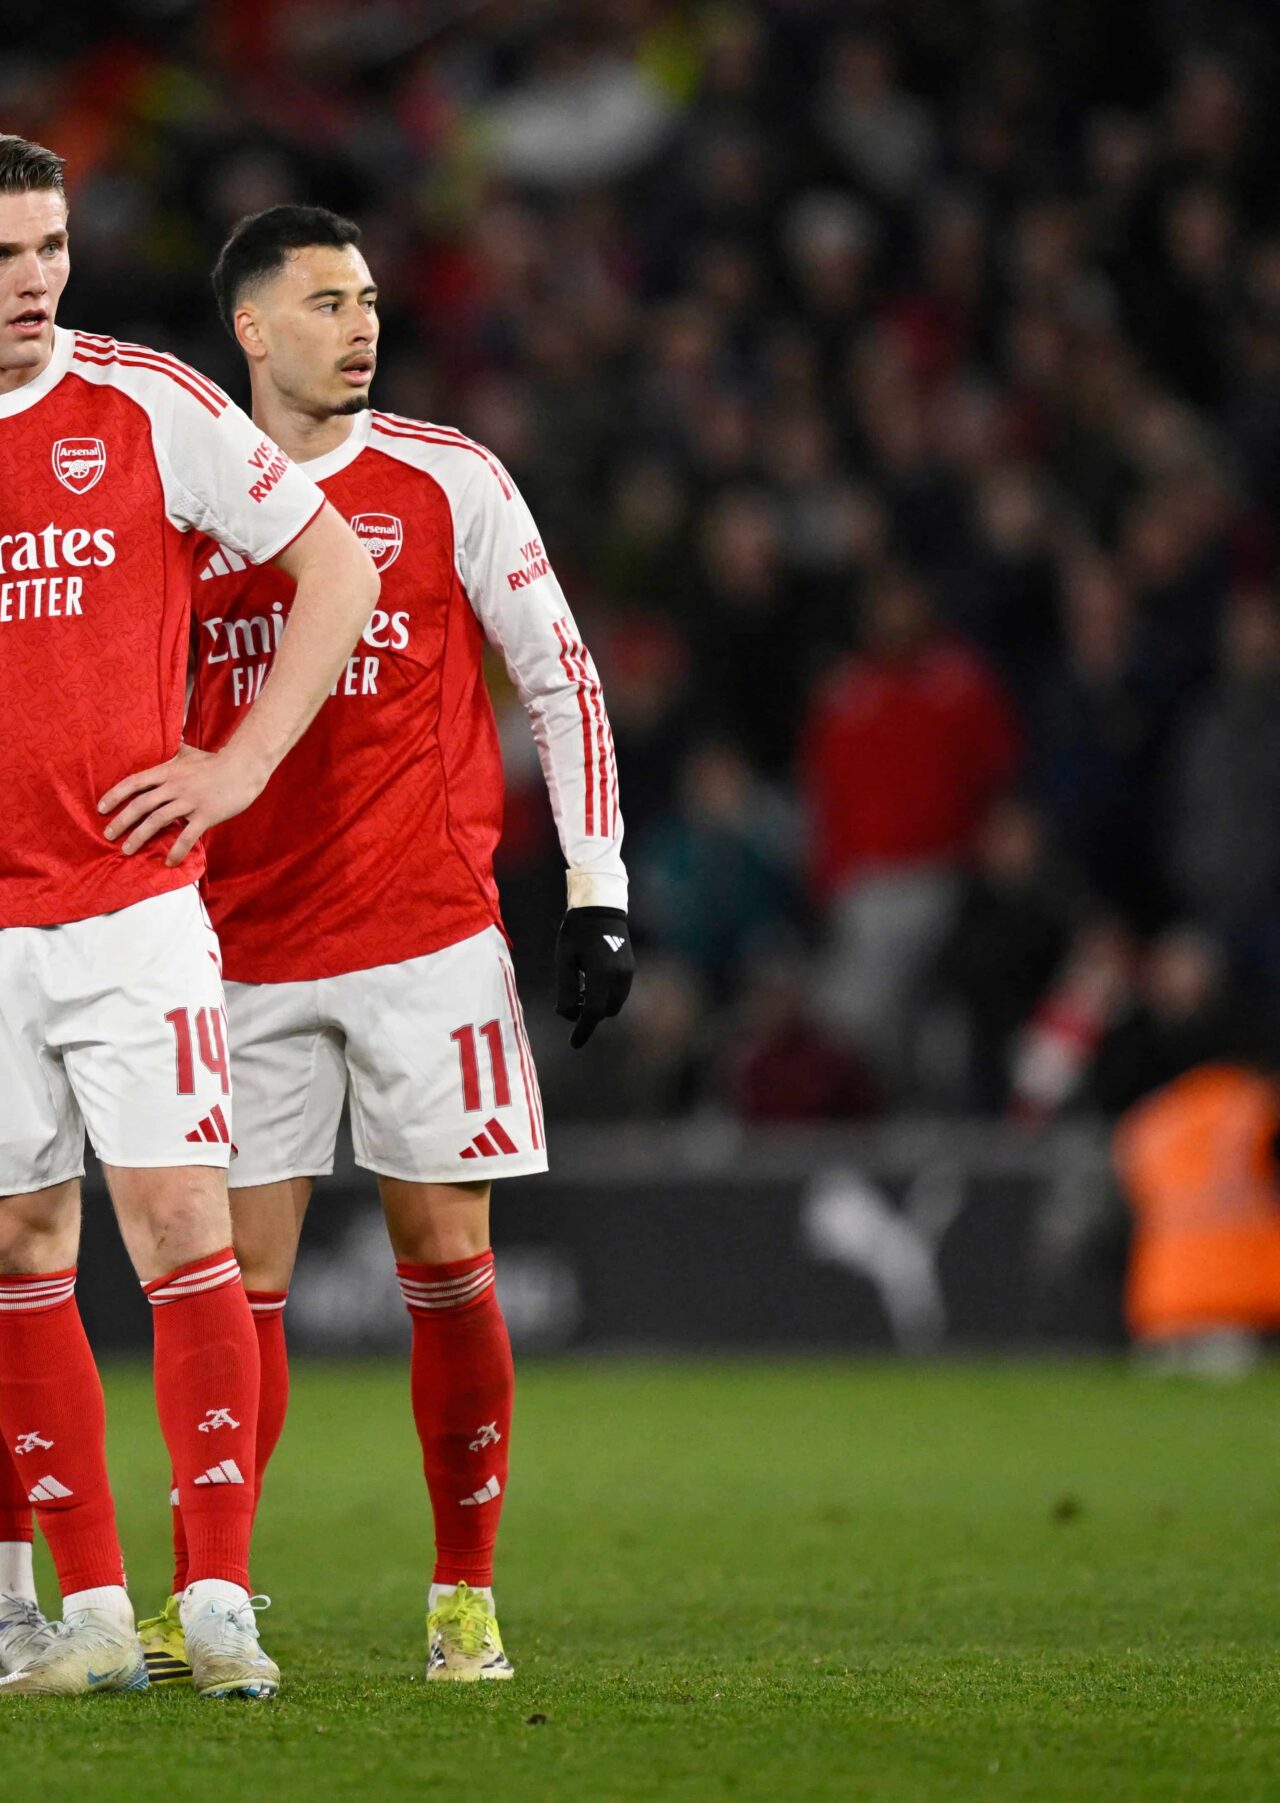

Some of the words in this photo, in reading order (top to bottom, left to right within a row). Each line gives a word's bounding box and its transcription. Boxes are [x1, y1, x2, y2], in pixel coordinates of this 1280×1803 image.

[60, 447, 98, 457] Arsenal
[248, 441, 273, 469] VIS
[248, 447, 289, 504] RWAN
[357, 522, 396, 535] Arsenal
[520, 539, 543, 562] VIS
[507, 558, 553, 592] RWAN
[164, 1006, 230, 1096] 14
[450, 1018, 512, 1113] 11
